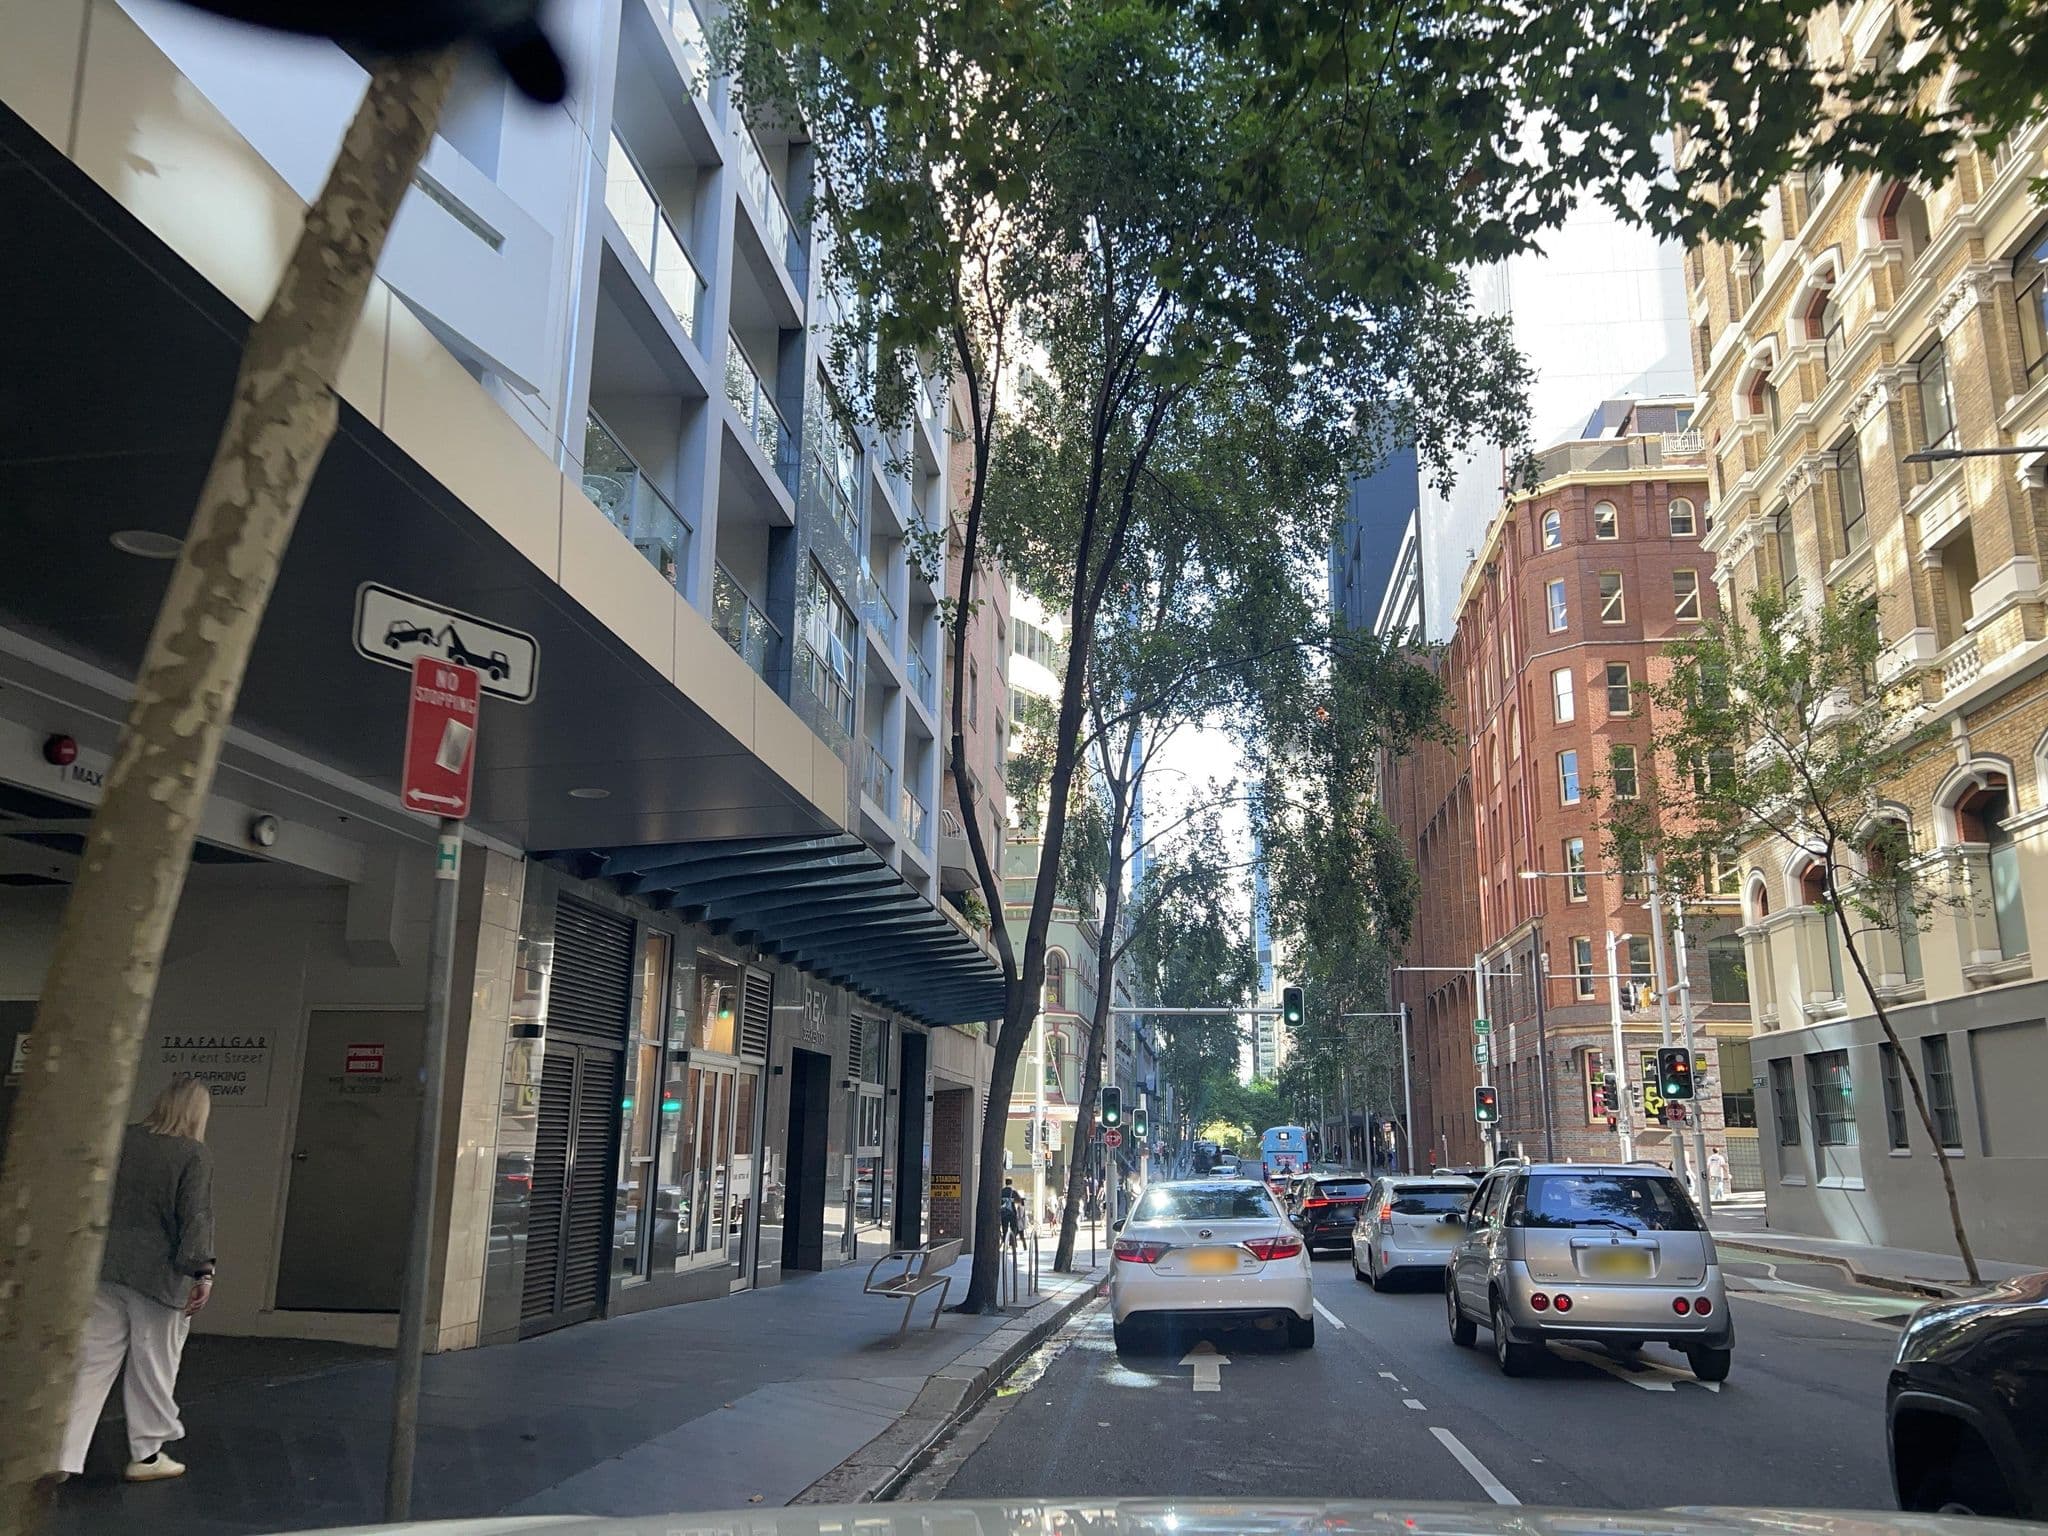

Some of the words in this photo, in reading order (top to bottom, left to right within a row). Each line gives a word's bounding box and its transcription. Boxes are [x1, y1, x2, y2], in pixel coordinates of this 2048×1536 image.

[435, 668, 459, 692] NO
[415, 686, 477, 714] STOPPING
[72, 765, 104, 788] MAX
[804, 987, 828, 1025] REX
[163, 1036, 266, 1048] TRAFALGAR
[191, 1052, 218, 1062] Kent
[224, 1051, 263, 1063] Street
[194, 1071, 247, 1081] PARKING
